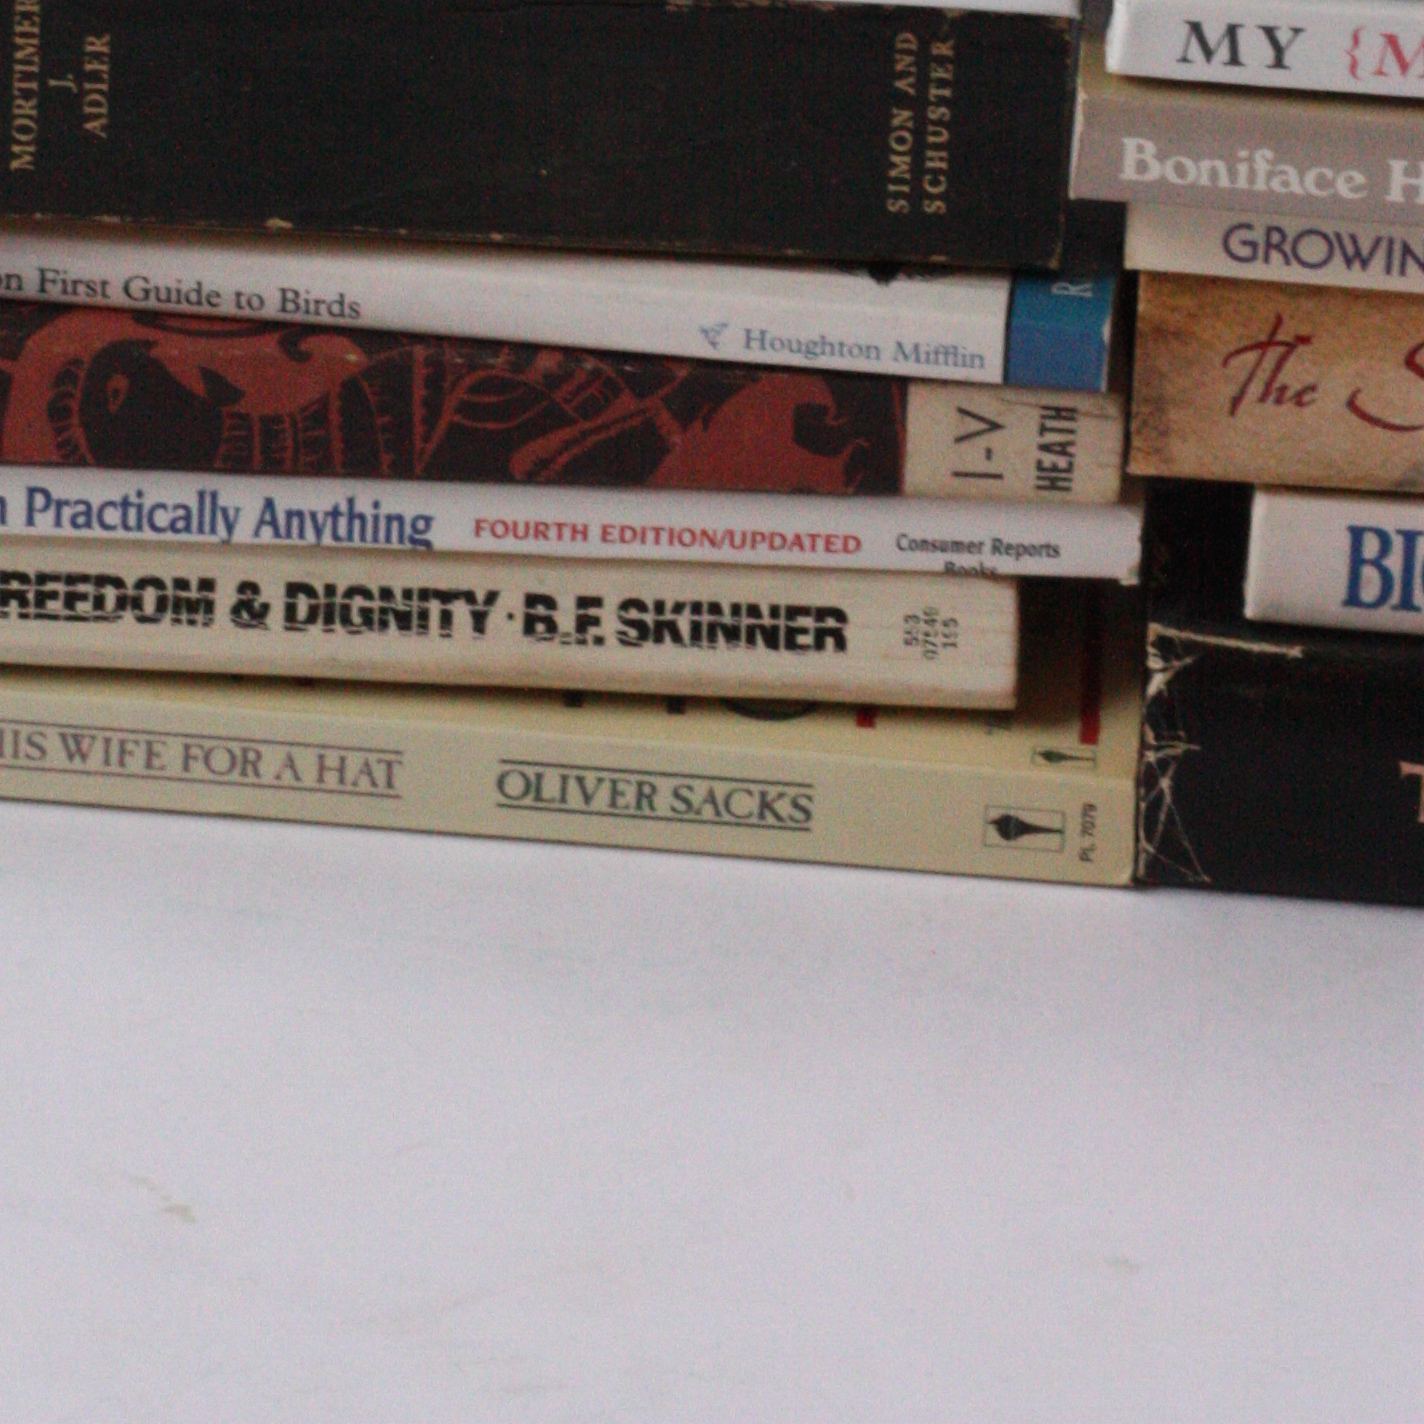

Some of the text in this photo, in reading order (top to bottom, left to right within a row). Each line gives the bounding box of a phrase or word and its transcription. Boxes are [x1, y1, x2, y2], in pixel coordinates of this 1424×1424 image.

[1176, 19, 1306, 71] MY
[82, 33, 111, 140] ADLER
[886, 31, 919, 215] SIMON AND
[922, 39, 955, 215] SCHUSTER
[1118, 136, 1369, 200] Boniface
[37, 265, 112, 301] First
[122, 275, 222, 310] Guide
[233, 288, 266, 312] to
[277, 287, 362, 320] Birds
[743, 327, 987, 371] Houghton Mifflin
[1223, 312, 1319, 418] The
[1034, 404, 1077, 492] HEATH
[23, 486, 244, 545] Practically
[251, 496, 435, 550] Anything
[473, 518, 863, 554] FOURTH EDITION/UPDATED
[895, 532, 1061, 560] Consumer Reports
[228, 578, 272, 631] &
[282, 580, 502, 639] DIGNITY
[616, 598, 849, 653] SKINNER
[57, 733, 167, 772] WIFE
[180, 742, 264, 780] FOR
[273, 753, 304, 783] A
[316, 752, 404, 791] HAT
[496, 768, 815, 825] OLIVER SACKS
